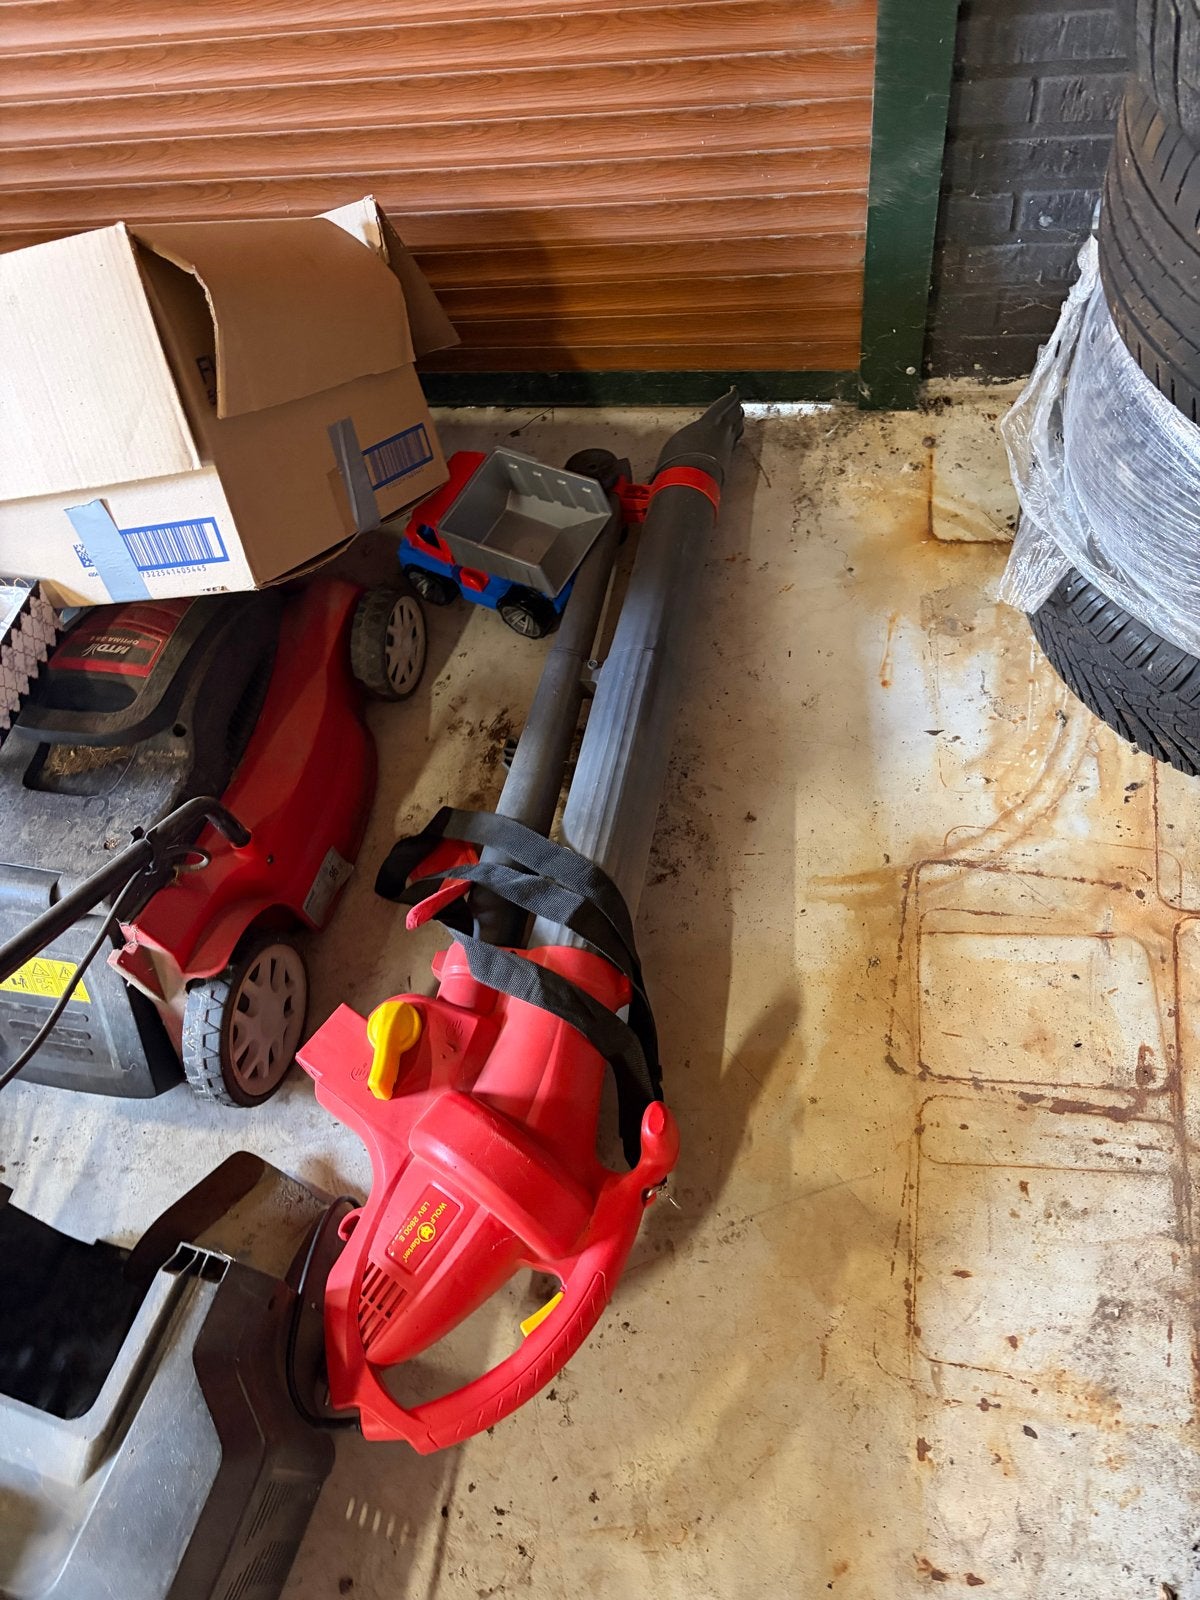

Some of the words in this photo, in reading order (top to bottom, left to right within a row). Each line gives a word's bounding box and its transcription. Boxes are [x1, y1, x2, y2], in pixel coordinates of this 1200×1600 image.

[108, 636, 140, 645] OPTIMA
[96, 643, 131, 655] MTD
[417, 1201, 430, 1217] LBV
[430, 1202, 448, 1224] WOLF
[403, 1238, 421, 1261] Garten
